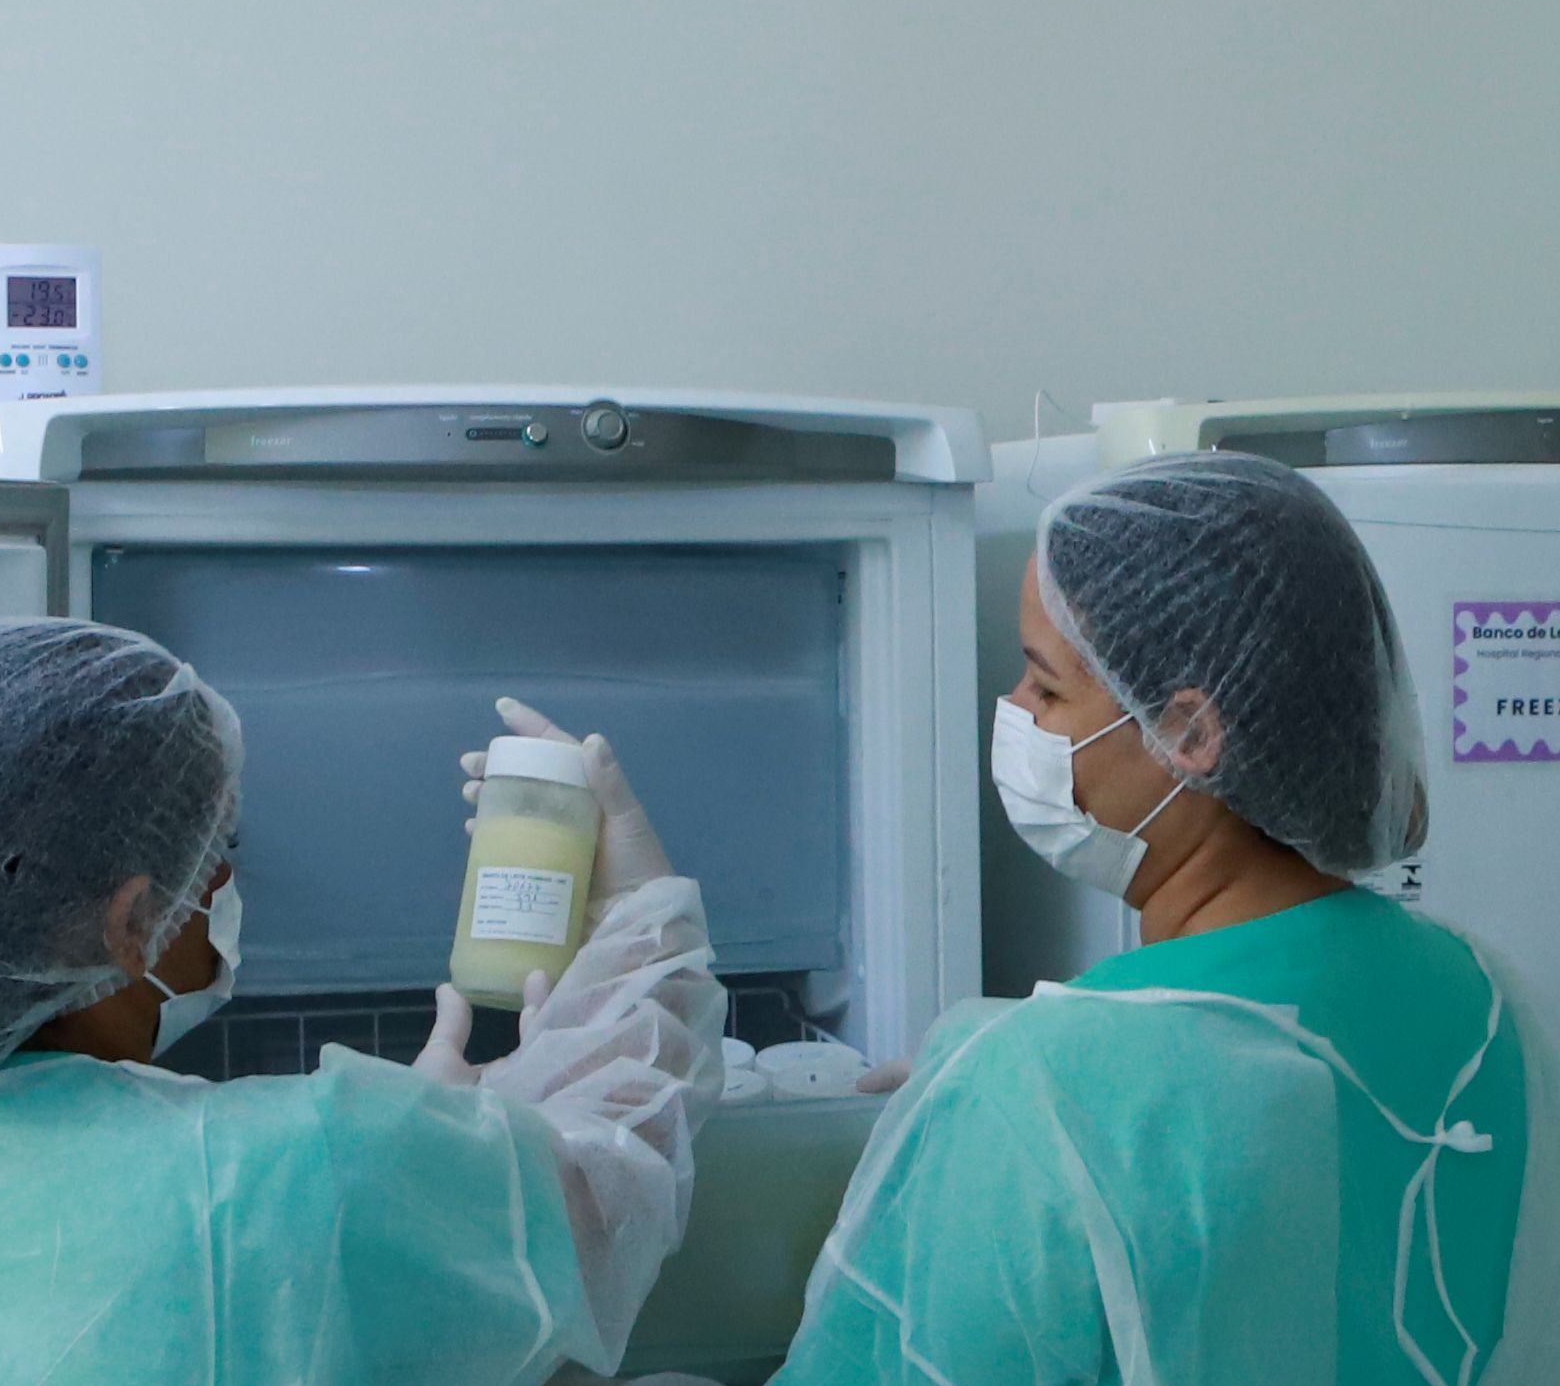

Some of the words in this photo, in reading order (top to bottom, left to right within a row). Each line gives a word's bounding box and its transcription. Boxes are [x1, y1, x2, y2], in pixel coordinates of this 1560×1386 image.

[1472, 625, 1524, 639] Banco
[1527, 625, 1546, 639] de
[1477, 649, 1519, 660] Hospital
